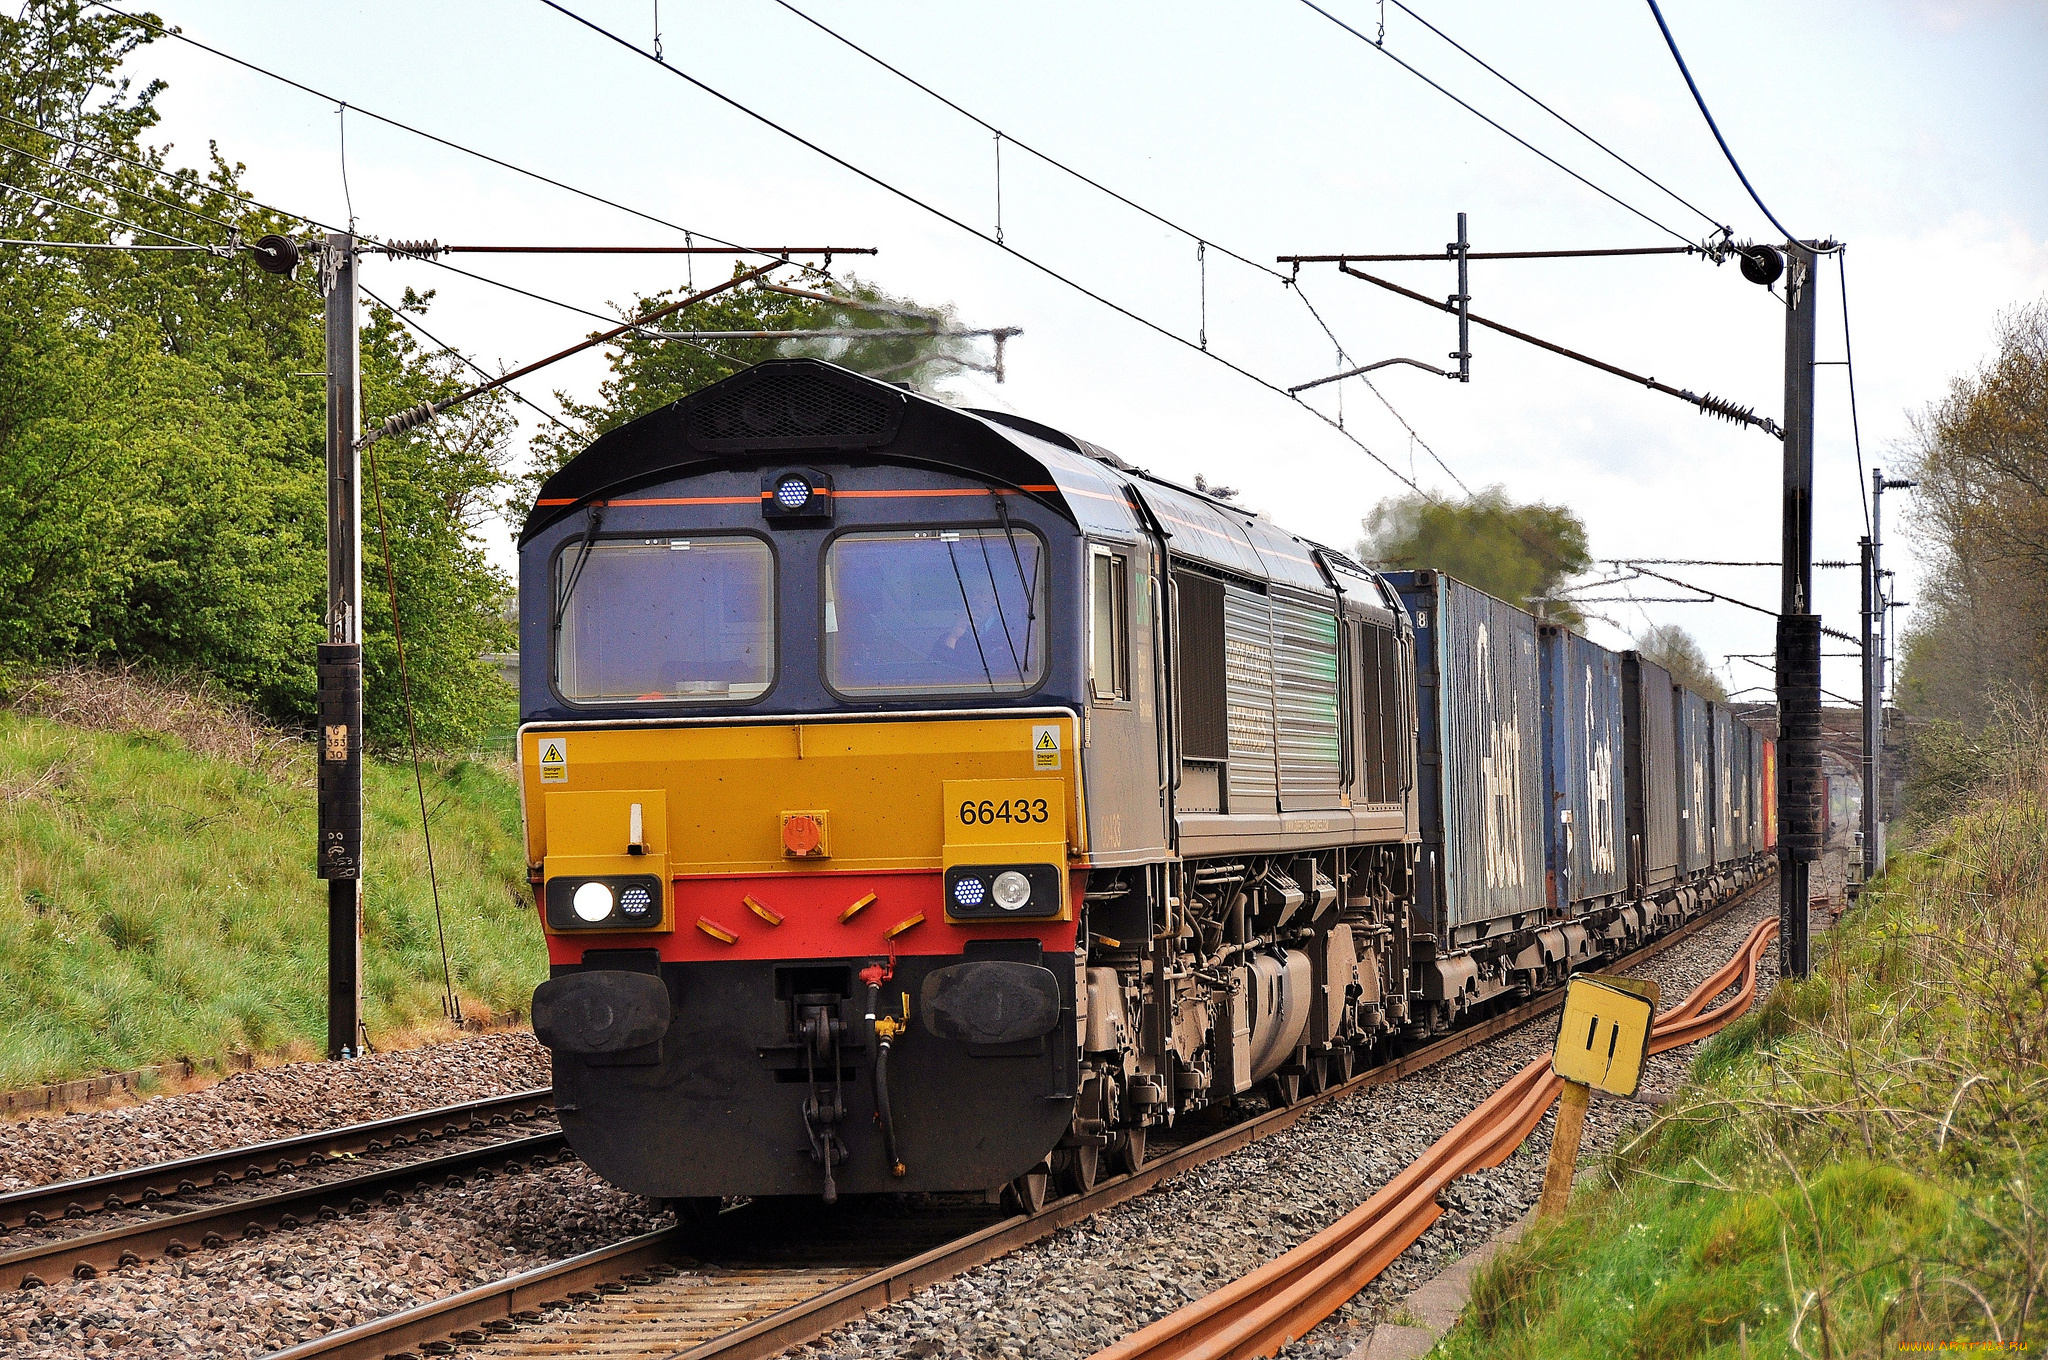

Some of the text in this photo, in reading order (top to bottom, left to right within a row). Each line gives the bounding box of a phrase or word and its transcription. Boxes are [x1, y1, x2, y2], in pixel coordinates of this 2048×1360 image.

[1418, 612, 1426, 627] 8
[327, 739, 346, 747] 353
[330, 751, 343, 759] 30
[960, 798, 1049, 825] 66433
